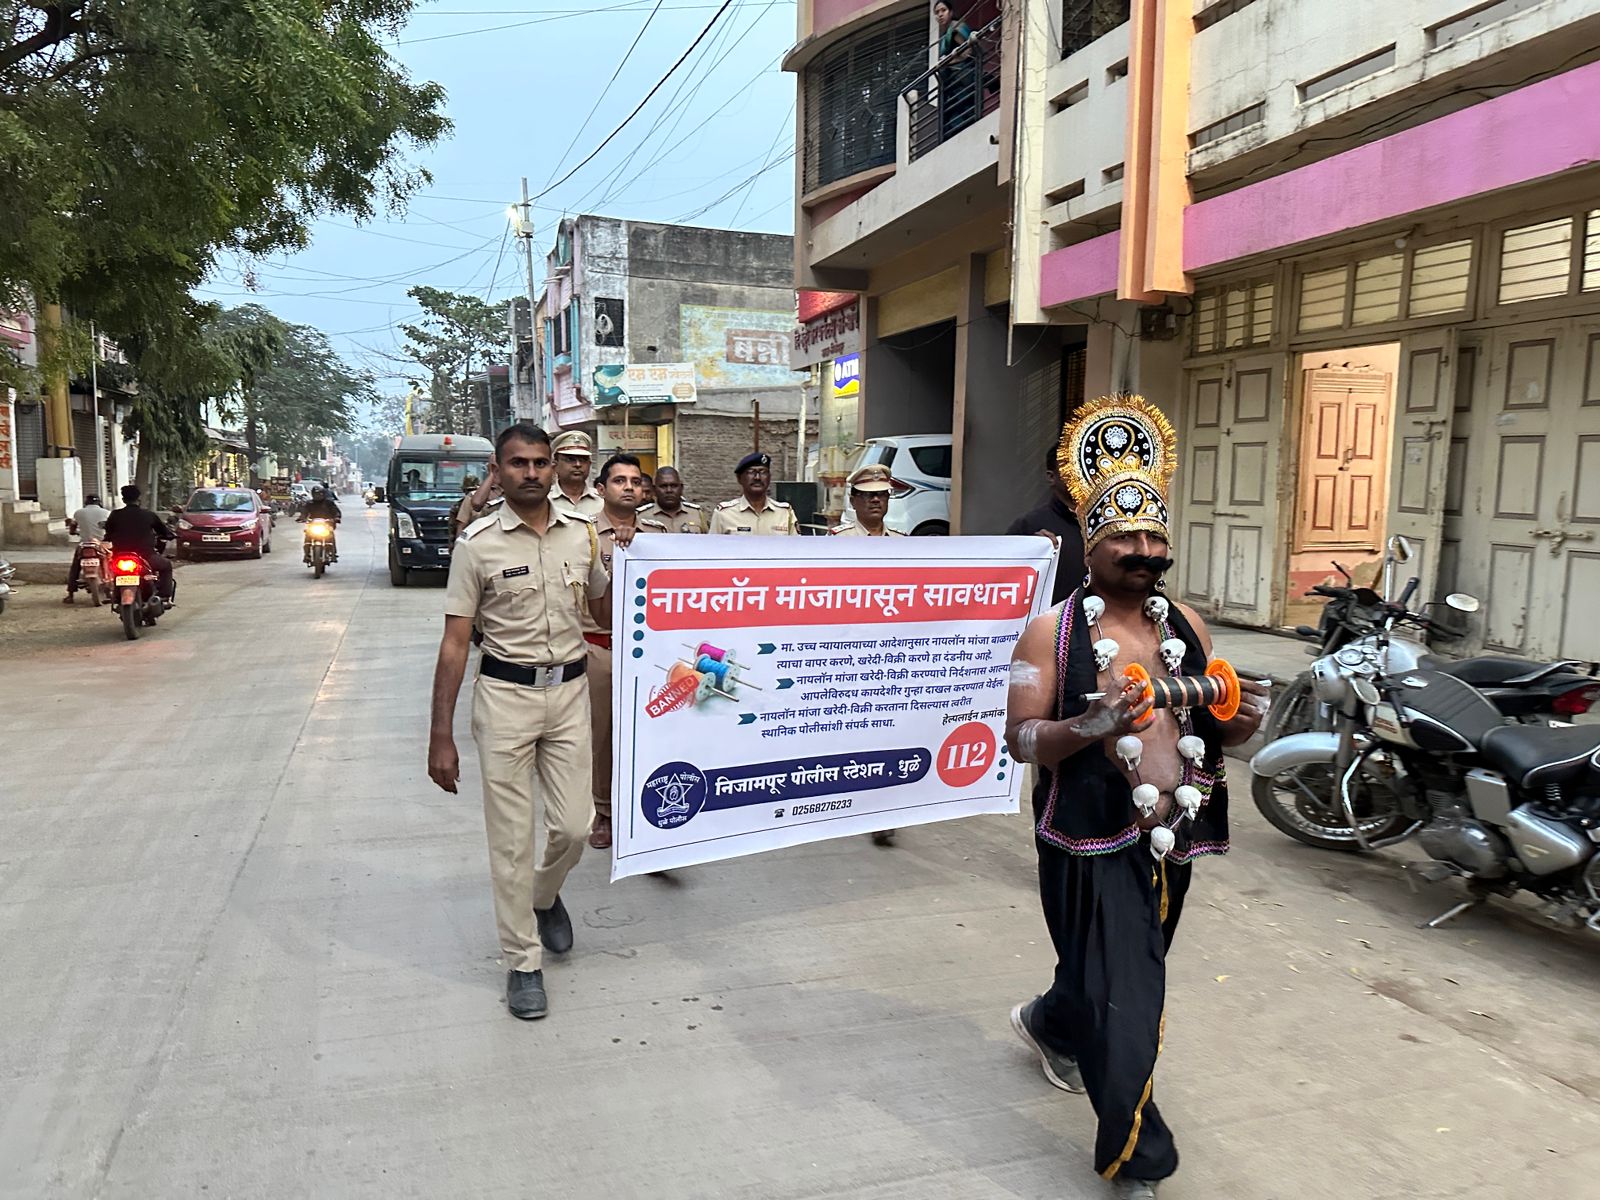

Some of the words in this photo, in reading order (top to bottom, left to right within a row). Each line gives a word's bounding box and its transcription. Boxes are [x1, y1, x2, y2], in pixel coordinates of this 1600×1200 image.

[651, 577, 769, 613] नायलॉन
[776, 577, 917, 616] मांजापासून
[781, 643, 795, 652] मा.
[797, 642, 817, 651] उच्च
[819, 640, 877, 650] न्यायालयाच्या
[879, 637, 930, 649] आदेशानुसार
[932, 634, 965, 646] नायलॉन
[967, 635, 989, 645] मांजा
[776, 660, 803, 669] त्याचा
[805, 659, 827, 667] वापर
[829, 655, 855, 667] करणे,
[858, 651, 906, 665] खरेदी-विक्री
[908, 651, 930, 662] करणे
[932, 653, 941, 663] हा
[943, 650, 973, 661] दंडनीय
[975, 649, 993, 660] आहे.
[796, 672, 833, 684] नायलॉन
[835, 672, 858, 682] मांजा
[860, 668, 909, 681] खरेदी-विक्री
[911, 667, 947, 678] करण्याचे
[649, 676, 696, 717] BANNED
[861, 685, 902, 697] कायदेशीर
[904, 686, 923, 698] गुन्हा
[925, 685, 951, 695] दाखल
[953, 682, 984, 692] करण्यात
[986, 678, 1005, 689] येईल.
[760, 708, 796, 721] नायलॉन
[798, 706, 821, 717] मांजा
[823, 702, 873, 715] खरेदी-विक्री
[875, 702, 908, 712] करताना
[911, 700, 949, 710] दिसल्यास
[951, 696, 973, 707] त्वरीत
[942, 710, 978, 726] हेल्पलाईन
[980, 708, 1006, 719] क्रमांक
[761, 725, 797, 738] स्थानिक
[799, 720, 843, 734] पोलीसांशी
[845, 718, 869, 730] संपर्क
[871, 719, 895, 728] साधा.
[944, 741, 987, 771] 112
[715, 776, 787, 796] निजामपूर
[791, 765, 839, 786] पोलीस
[843, 760, 885, 780] स्टेशन
[898, 755, 922, 779] धुळे
[792, 799, 852, 817] 02568276233
